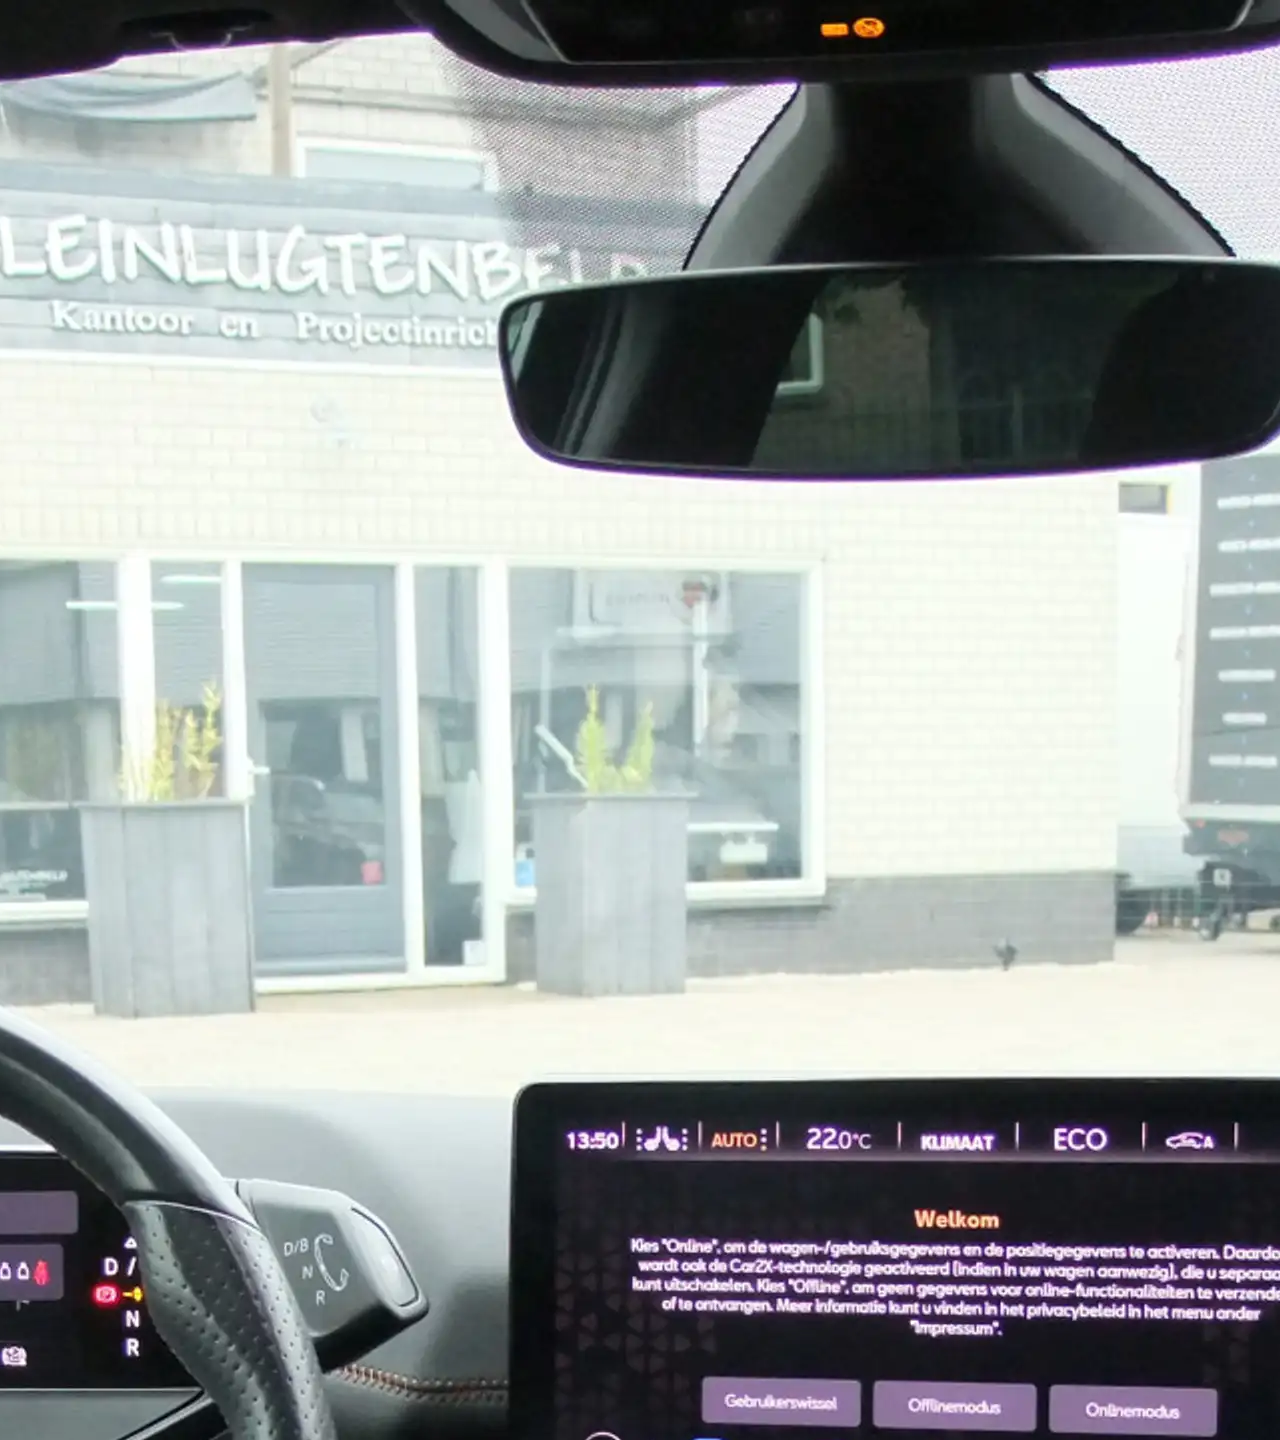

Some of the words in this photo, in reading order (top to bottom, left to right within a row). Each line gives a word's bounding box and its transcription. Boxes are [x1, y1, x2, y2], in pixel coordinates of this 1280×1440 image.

[50, 301, 195, 337] Kantoor
[220, 315, 260, 338] en
[567, 1131, 620, 1150] 13:50
[711, 1132, 757, 1149] AUTO
[920, 1134, 995, 1151] KLIMAAT
[1053, 1127, 1107, 1151] ECO
[914, 1209, 1000, 1229] Welkom
[283, 1240, 309, 1257] D/B
[631, 1238, 659, 1253] Kies
[723, 1242, 747, 1254] om
[749, 1240, 767, 1254] de
[963, 1245, 982, 1257] en
[984, 1243, 1004, 1257] de
[1006, 1243, 1127, 1261] positiegegevens
[1130, 1246, 1145, 1258] te
[1147, 1245, 1220, 1260] activeren.
[301, 1265, 314, 1280] N
[638, 1258, 679, 1272] wordt
[681, 1259, 707, 1273] ook
[709, 1259, 728, 1273] de
[730, 1259, 862, 1276] Car2X-technologie
[864, 1261, 949, 1277] geactiveerd
[1004, 1263, 1017, 1277] in
[1019, 1265, 1041, 1277] uw
[1043, 1265, 1095, 1281] wagen
[1180, 1265, 1204, 1280] die
[1207, 1269, 1216, 1280] u
[315, 1291, 326, 1305] R
[631, 1278, 662, 1292] kunt
[664, 1278, 754, 1293] uitschakelen.
[757, 1279, 786, 1293] Kies
[852, 1283, 876, 1294] om
[878, 1283, 914, 1298] geen
[916, 1284, 988, 1299] gegevens
[990, 1285, 1022, 1297] voor
[1025, 1283, 1194, 1301] online-functionaliteiten
[1197, 1287, 1212, 1300] te
[661, 1297, 678, 1311] of
[679, 1298, 693, 1311] te
[694, 1298, 774, 1315] ontvangen.
[776, 1299, 813, 1313] Meer
[815, 1299, 887, 1315] informatie
[888, 1300, 920, 1315] kunt
[922, 1304, 932, 1315] u
[933, 1301, 982, 1316] vinden
[983, 1302, 998, 1316] in
[1000, 1302, 1024, 1317] het
[1026, 1303, 1127, 1321] privacybeleid
[1128, 1304, 1142, 1319] in
[1144, 1304, 1169, 1320] het
[1171, 1308, 1214, 1320] menu
[1216, 1306, 1262, 1321] onder
[125, 1310, 140, 1328] N
[125, 1339, 140, 1357] R
[724, 1394, 838, 1412] Gebruikerswissel
[908, 1397, 1001, 1415] Offlinemodus
[1086, 1402, 1181, 1420] Onlinemodus
